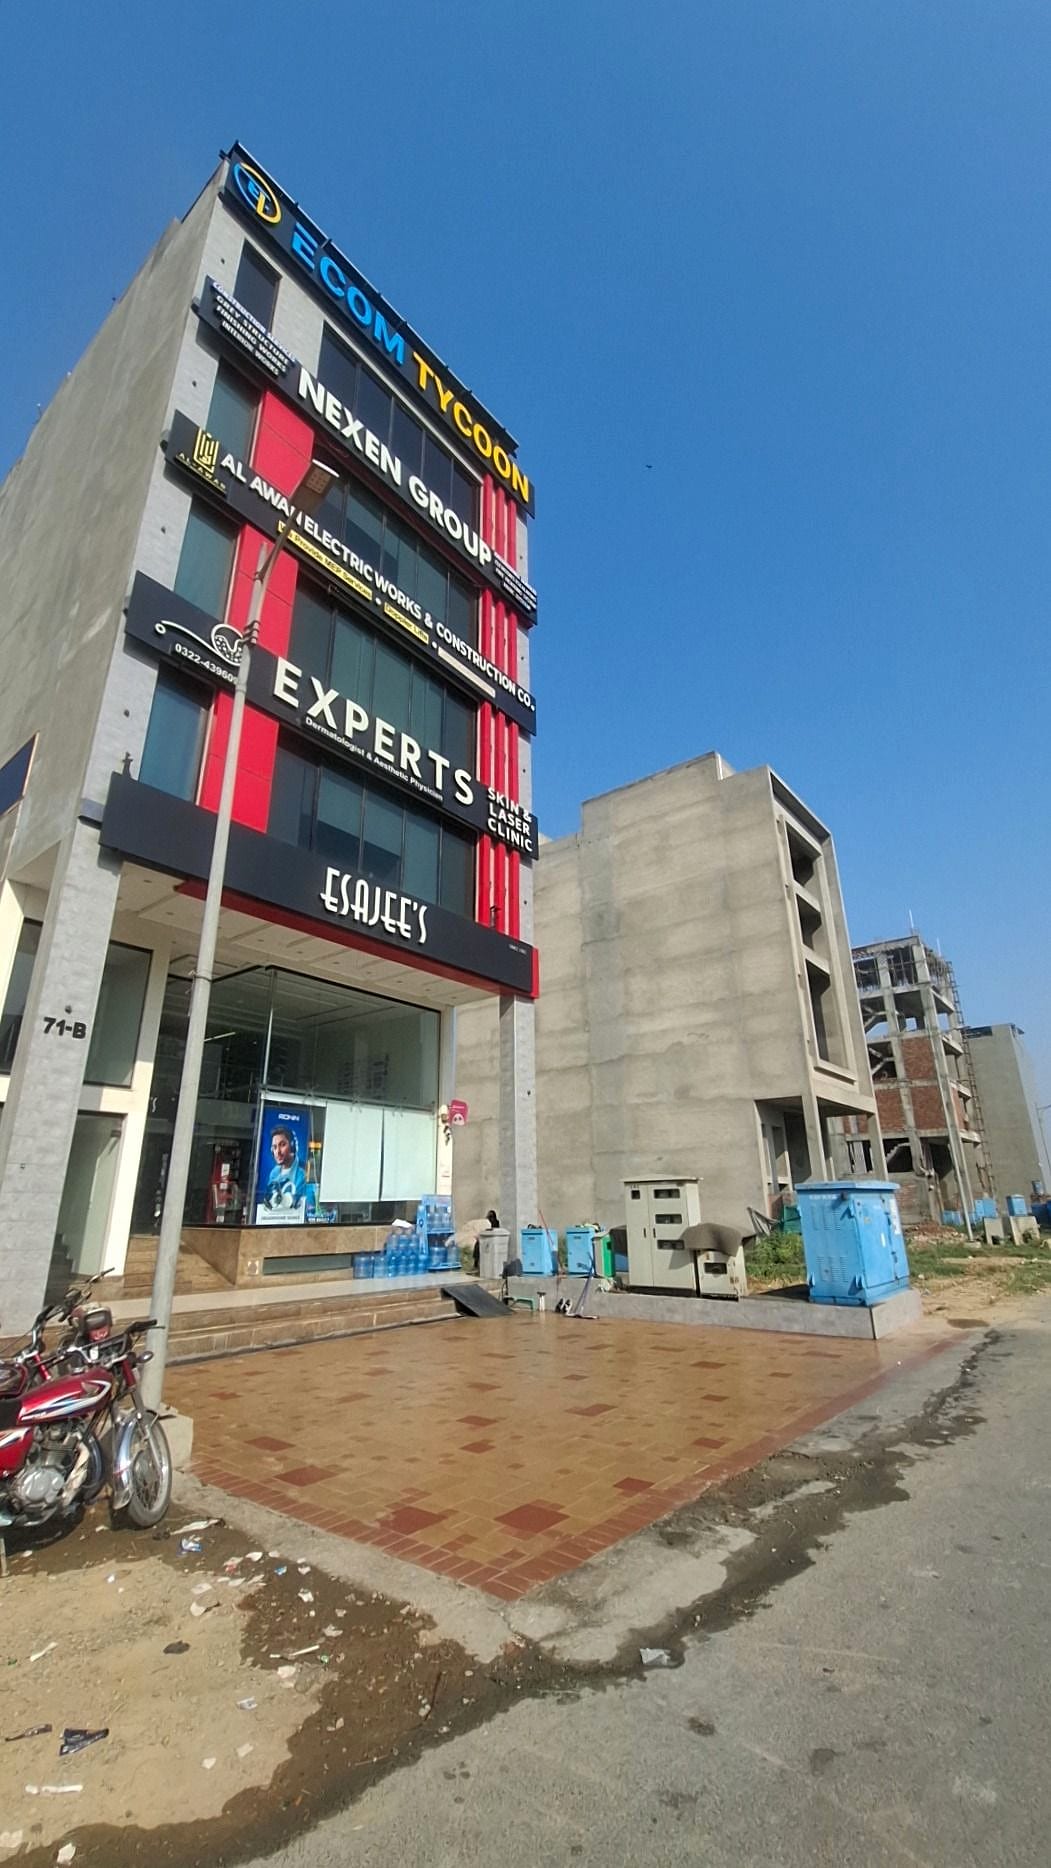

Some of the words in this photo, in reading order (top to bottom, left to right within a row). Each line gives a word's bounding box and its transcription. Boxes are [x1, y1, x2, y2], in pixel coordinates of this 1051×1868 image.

[216, 295, 241, 319] GREY
[242, 319, 289, 365] STRUCTURE
[216, 305, 257, 345] FINISHING
[259, 343, 287, 372] WORKS
[255, 349, 280, 375] WORKS
[291, 221, 404, 365] ECOM
[413, 351, 528, 503] TYCOON
[299, 367, 402, 486] NEXEN
[409, 475, 492, 566] GROUP
[220, 453, 247, 483] AL
[304, 515, 373, 581] ELECTRIC
[375, 571, 422, 620] WORKS
[424, 613, 434, 630] &
[436, 621, 517, 696] CONSTRUCTION
[517, 689, 536, 712] CO.
[273, 656, 474, 806] EXPERTS
[305, 716, 365, 757] Dermatologist
[366, 752, 373, 761] &
[374, 757, 409, 782] Aesthetic
[410, 776, 444, 801] Physician
[488, 787, 519, 815] SKIN
[523, 806, 532, 823] &
[488, 818, 533, 852] CLINIC
[489, 803, 531, 836] LASER
[320, 866, 428, 944] ESAJEE'S
[43, 1016, 87, 1040] 71-B
